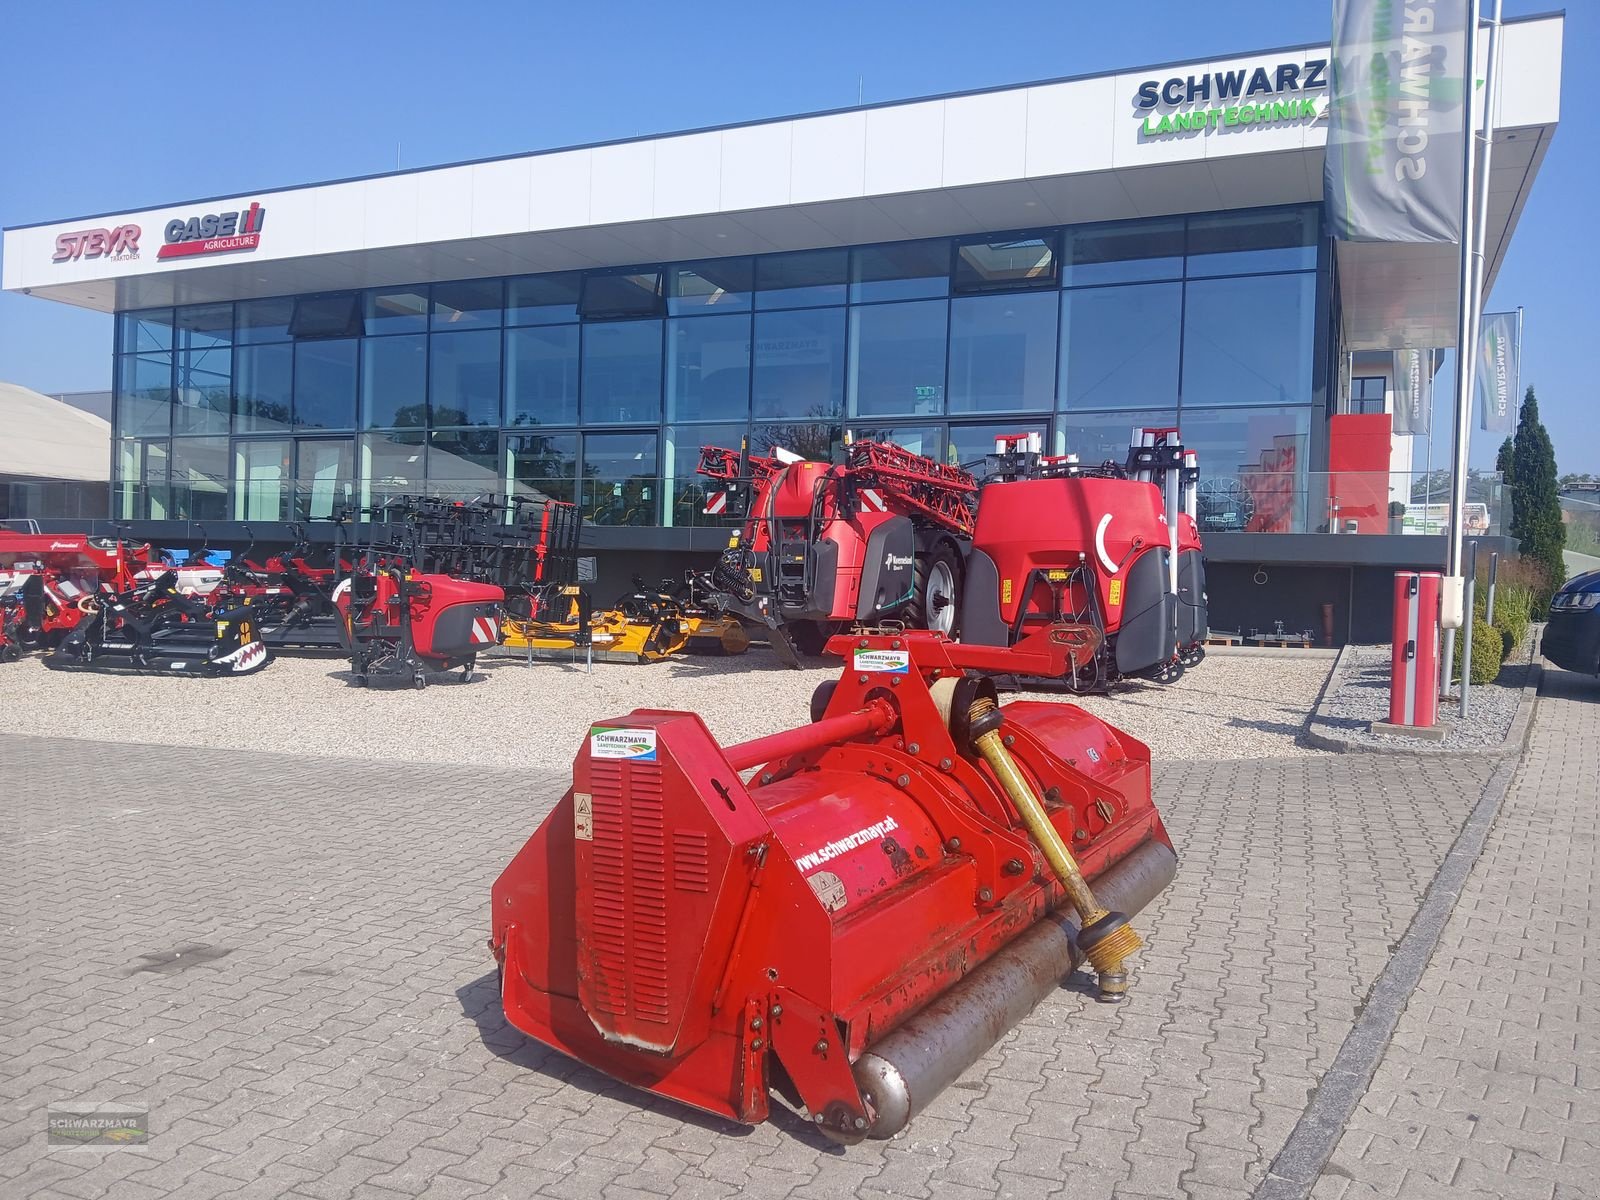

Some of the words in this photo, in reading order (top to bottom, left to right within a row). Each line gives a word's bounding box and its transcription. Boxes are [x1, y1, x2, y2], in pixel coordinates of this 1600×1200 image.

[1142, 98, 1317, 136] LANDTECHNIK
[164, 211, 239, 243] CASE
[52, 224, 142, 263] STEYR
[203, 236, 255, 251] AGRICULTURE
[110, 253, 140, 263] TRAKTOREN
[596, 735, 647, 743] SCHWARZMAYR
